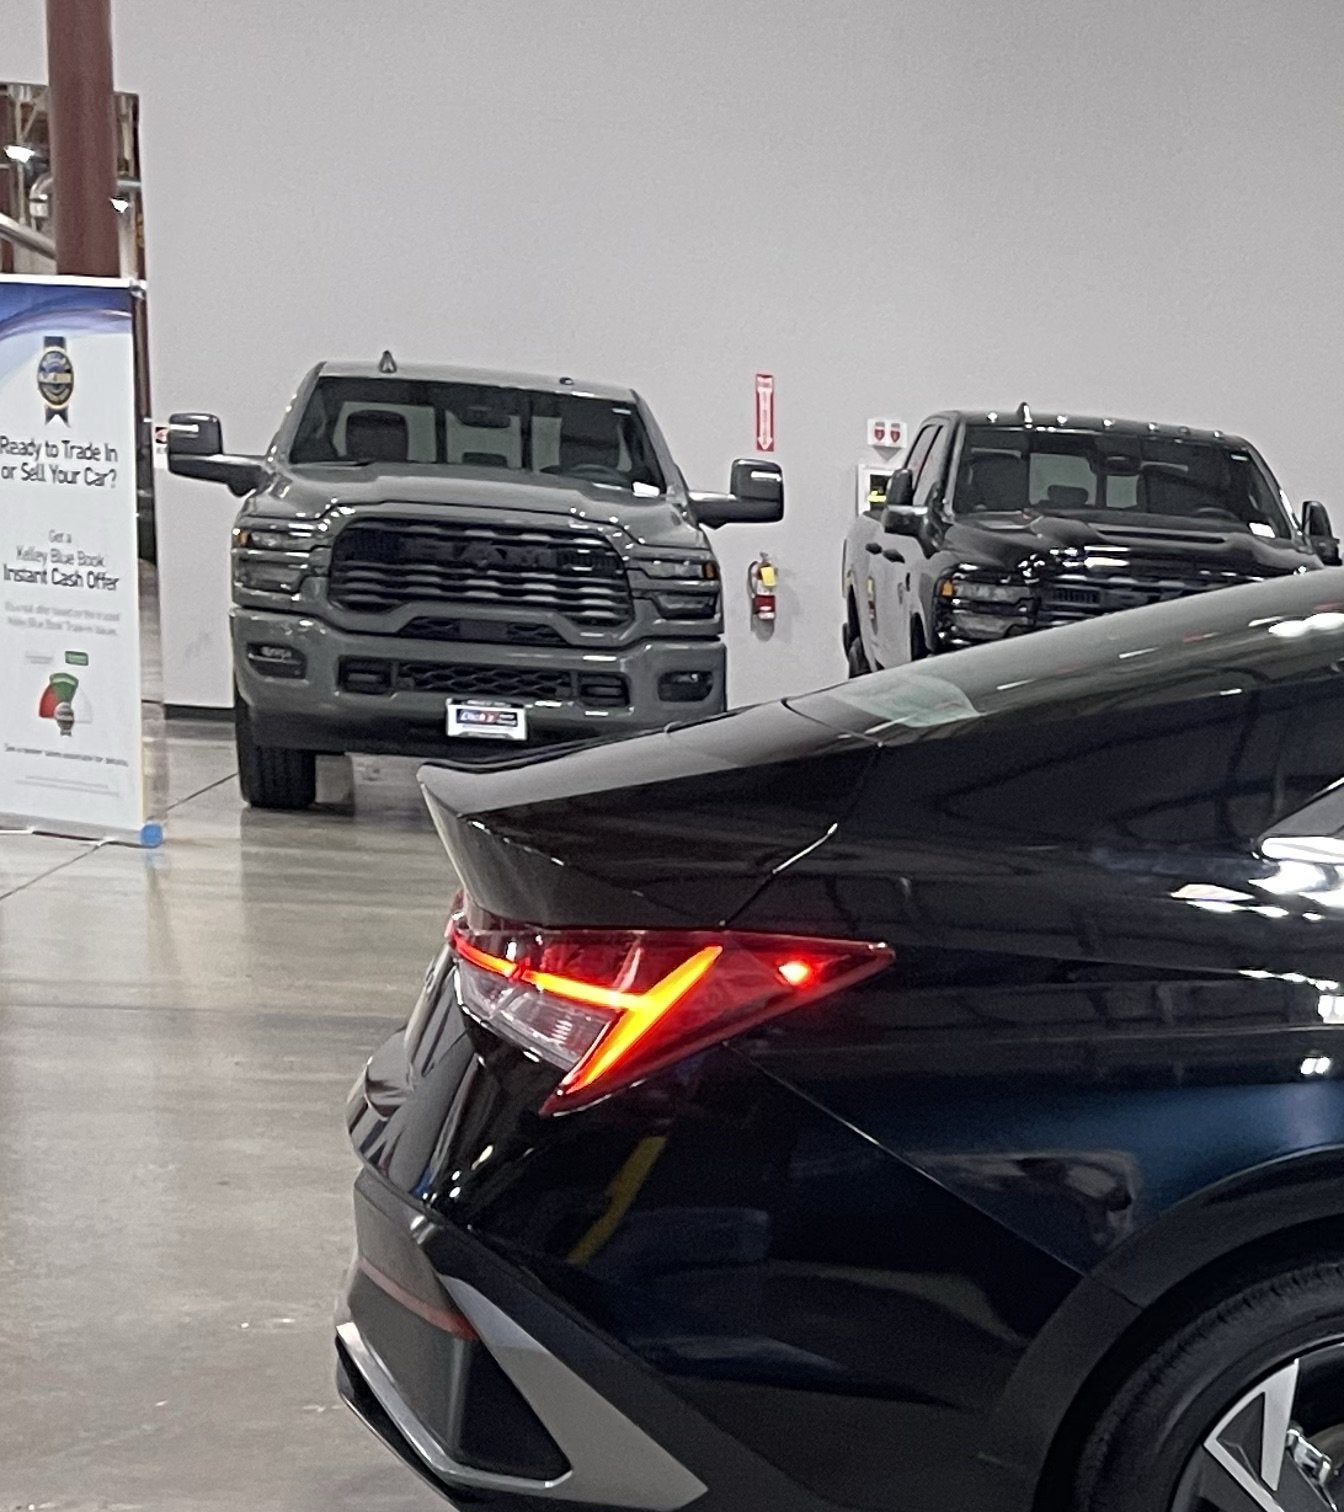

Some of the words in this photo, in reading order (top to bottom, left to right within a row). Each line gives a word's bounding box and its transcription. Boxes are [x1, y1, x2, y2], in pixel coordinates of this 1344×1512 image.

[0, 435, 42, 461] Ready
[45, 440, 59, 458] to
[61, 440, 101, 461] Trade
[104, 443, 118, 462] In
[1, 466, 17, 479] or
[21, 462, 46, 482] Sell
[49, 464, 80, 483] Your
[84, 466, 117, 488] Car?
[51, 567, 83, 587] Cash
[87, 570, 119, 591] Offer
